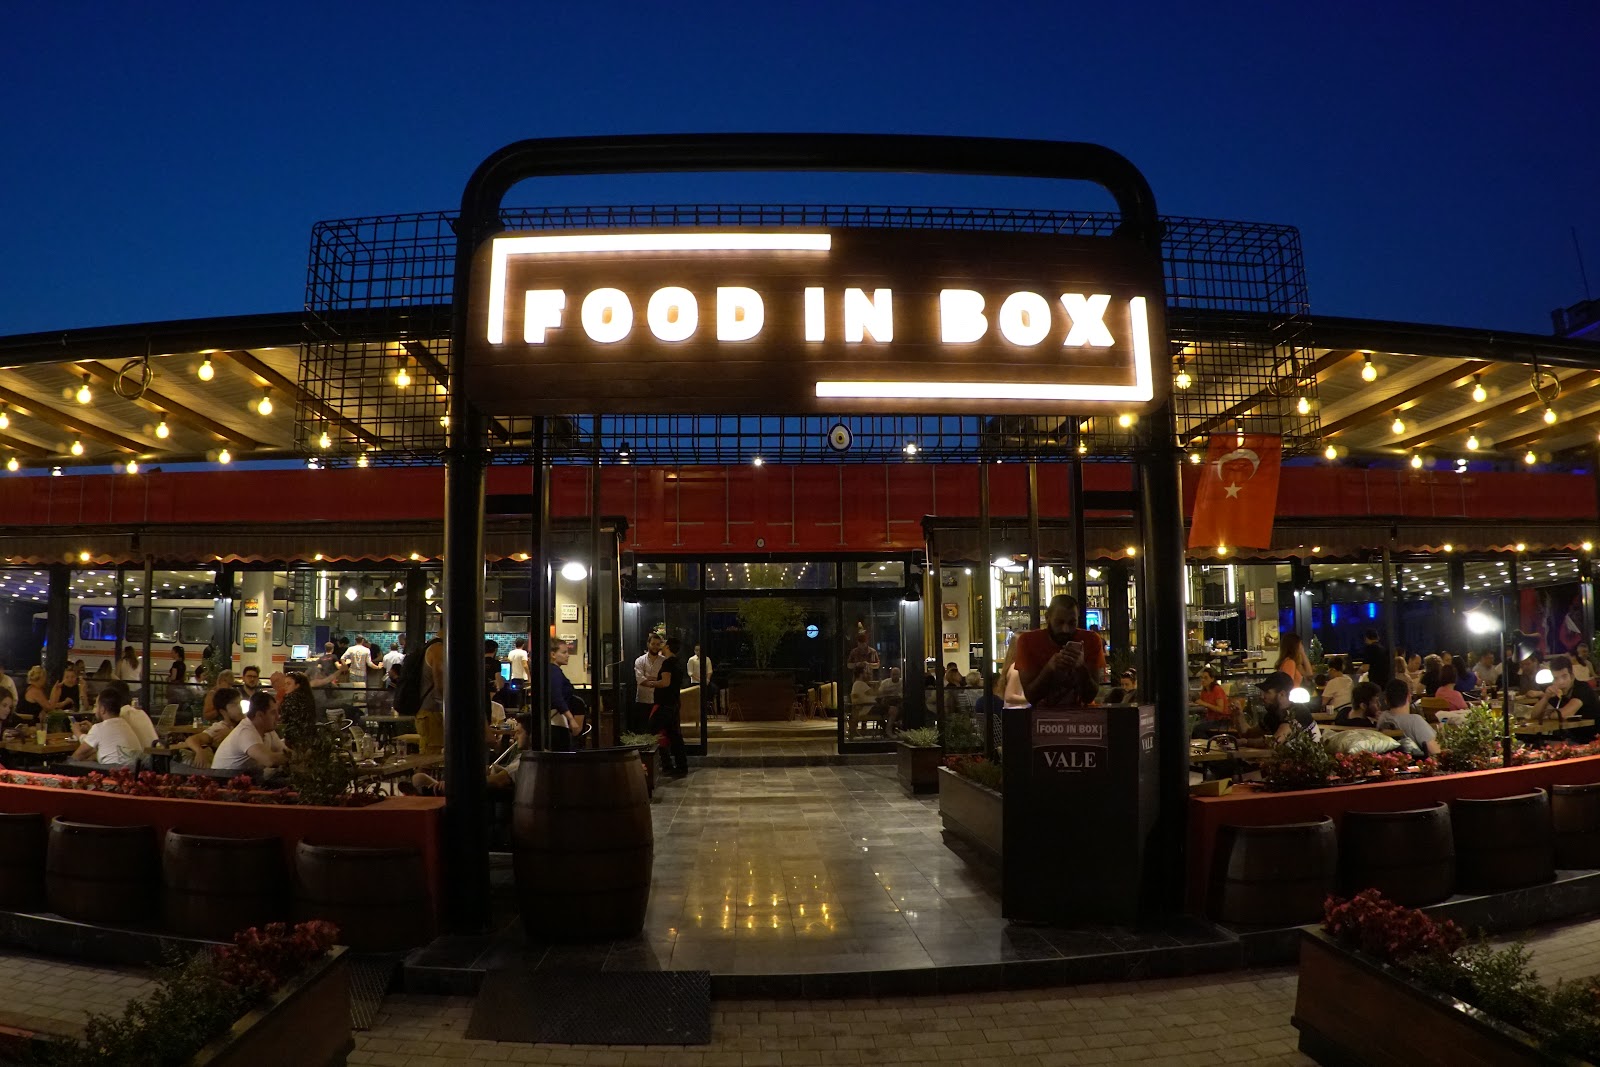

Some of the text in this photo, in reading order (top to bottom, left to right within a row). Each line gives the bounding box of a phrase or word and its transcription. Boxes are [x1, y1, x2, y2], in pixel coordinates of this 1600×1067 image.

[523, 286, 1115, 347] FOOD IN BOX
[1039, 724, 1099, 734] FOOD IN BOX
[1044, 751, 1097, 768] VALE
